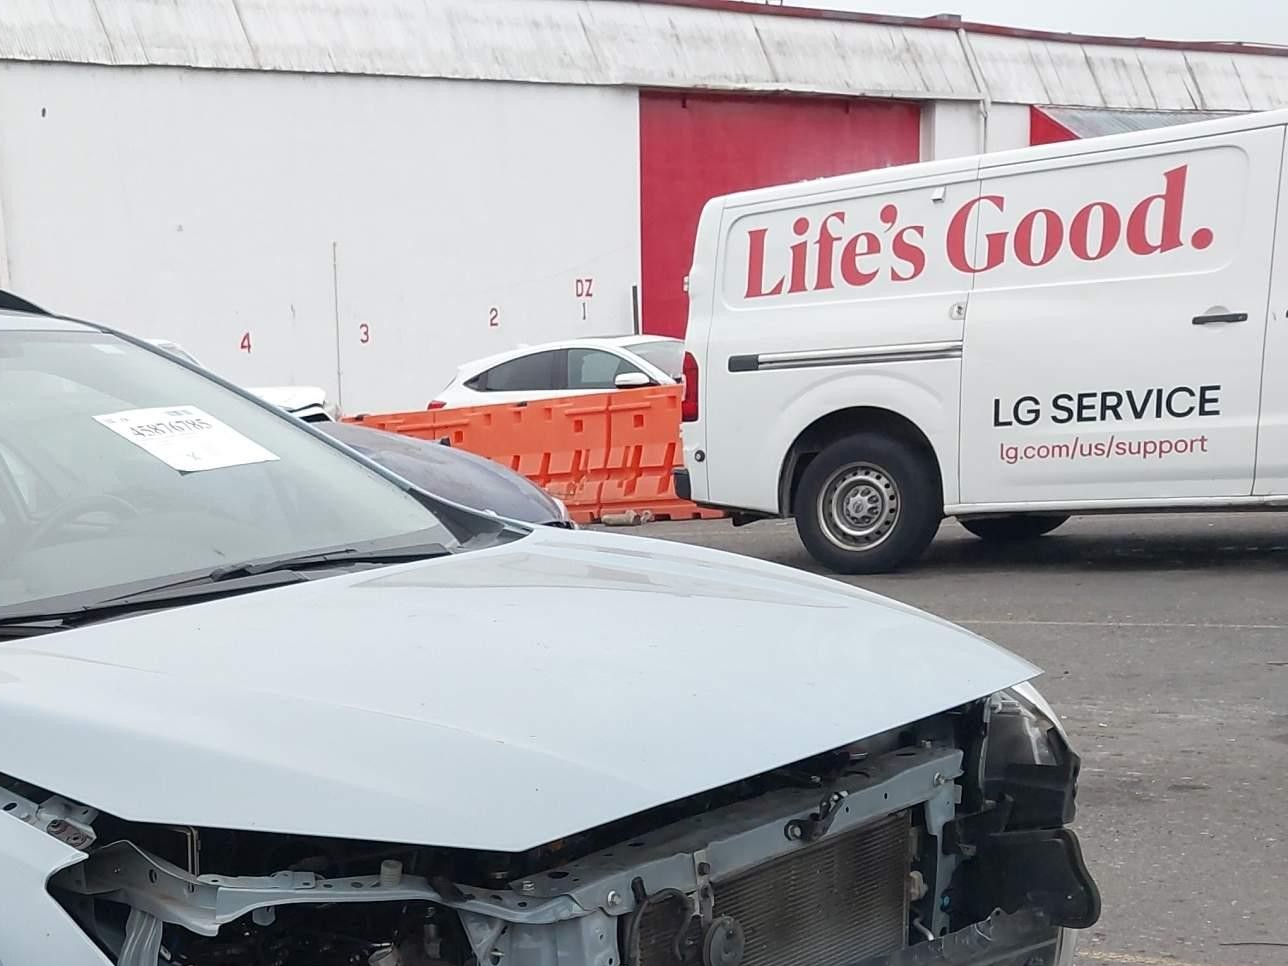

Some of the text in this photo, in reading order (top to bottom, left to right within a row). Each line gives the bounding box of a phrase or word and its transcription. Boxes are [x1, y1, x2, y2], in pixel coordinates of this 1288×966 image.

[744, 164, 1214, 299] Life's Good.
[575, 278, 593, 298] DZ
[488, 307, 499, 327] 2
[240, 332, 252, 354] 4
[359, 323, 370, 344] 3
[993, 385, 1221, 427] LG SERVICE
[1000, 435, 1209, 464] lg.com/us/support
